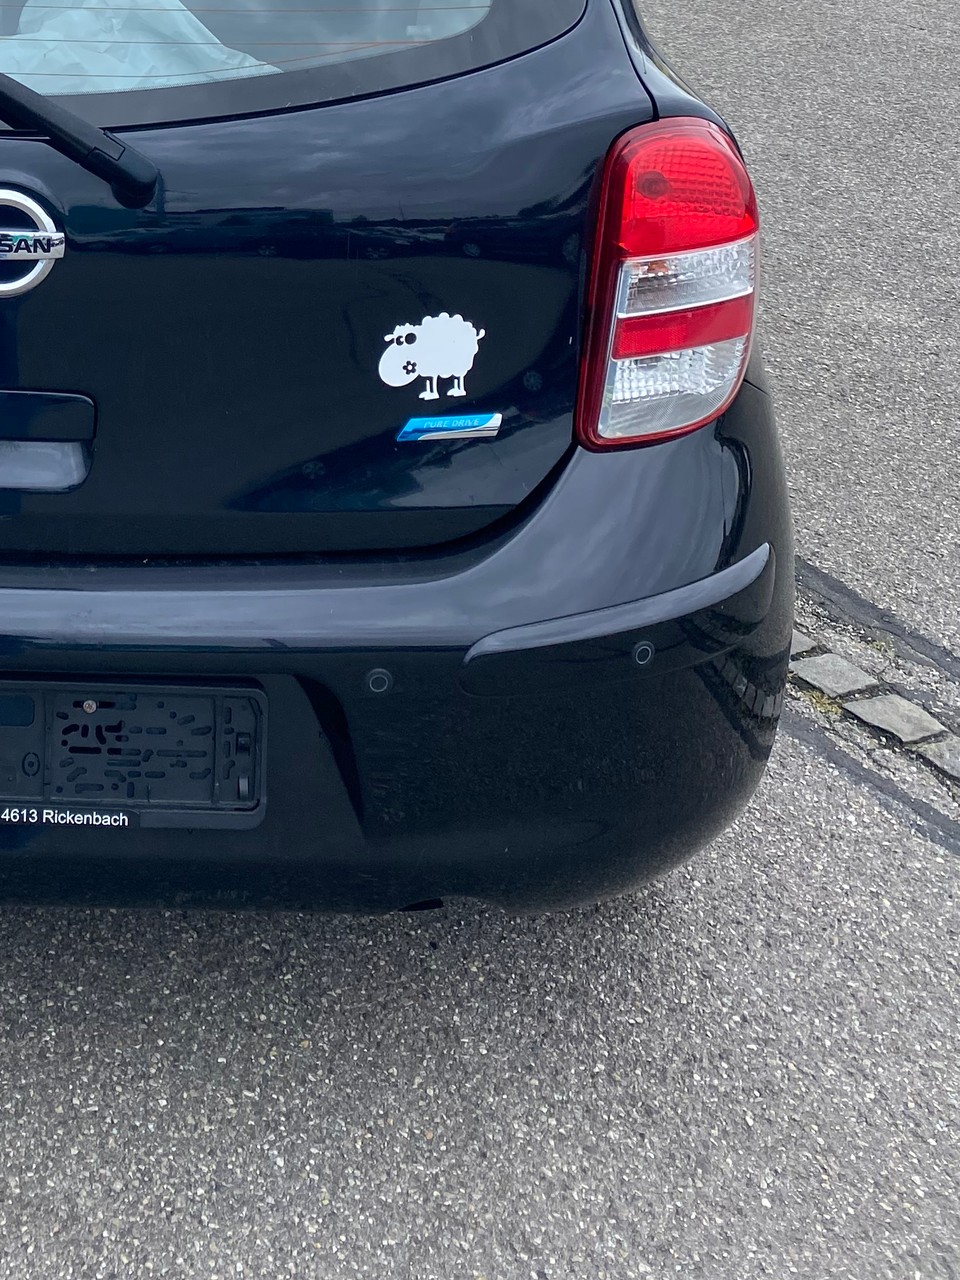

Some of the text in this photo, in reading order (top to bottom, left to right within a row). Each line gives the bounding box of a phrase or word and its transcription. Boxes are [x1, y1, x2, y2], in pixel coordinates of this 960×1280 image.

[423, 418, 480, 429] PURE DRIVE
[0, 808, 38, 823] 4613
[43, 810, 129, 826] Rickenbach
